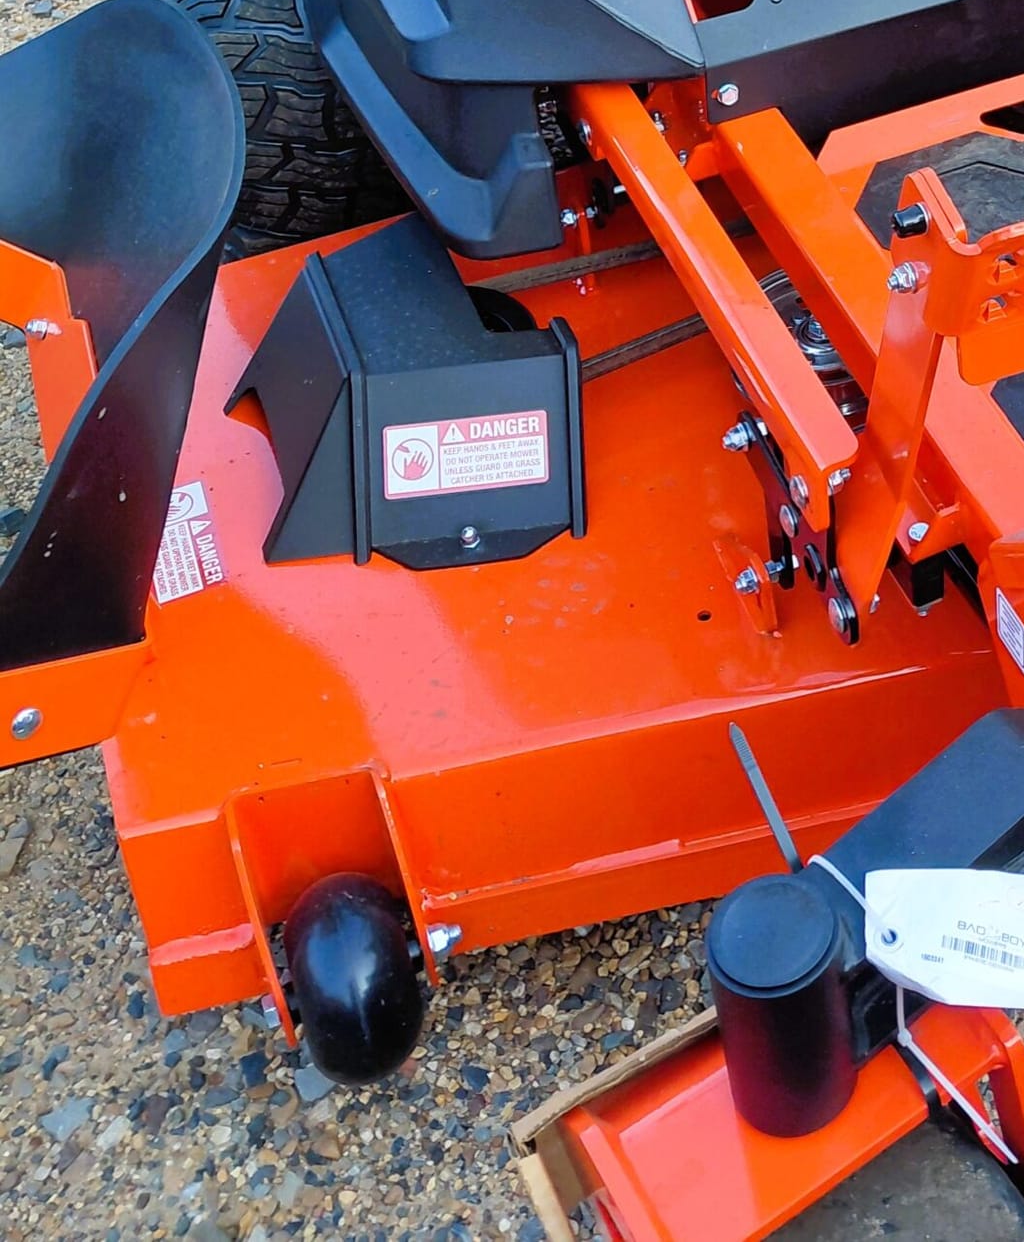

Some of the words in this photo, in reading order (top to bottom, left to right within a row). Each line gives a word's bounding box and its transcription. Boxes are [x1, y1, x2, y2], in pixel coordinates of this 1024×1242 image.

[469, 416, 540, 440] DANGER
[443, 444, 463, 455] KEEP
[464, 442, 490, 454] HANDS
[498, 440, 516, 450] FEET
[458, 456, 474, 465] NOT
[475, 452, 509, 464] OPERATE
[510, 448, 539, 460] MOWER
[444, 465, 474, 476] UNLESS
[475, 462, 501, 473] GUARD
[515, 457, 541, 468] GRASS
[451, 474, 485, 486] CATCHER
[195, 533, 224, 586] DANGER
[957, 920, 986, 936] BAD
